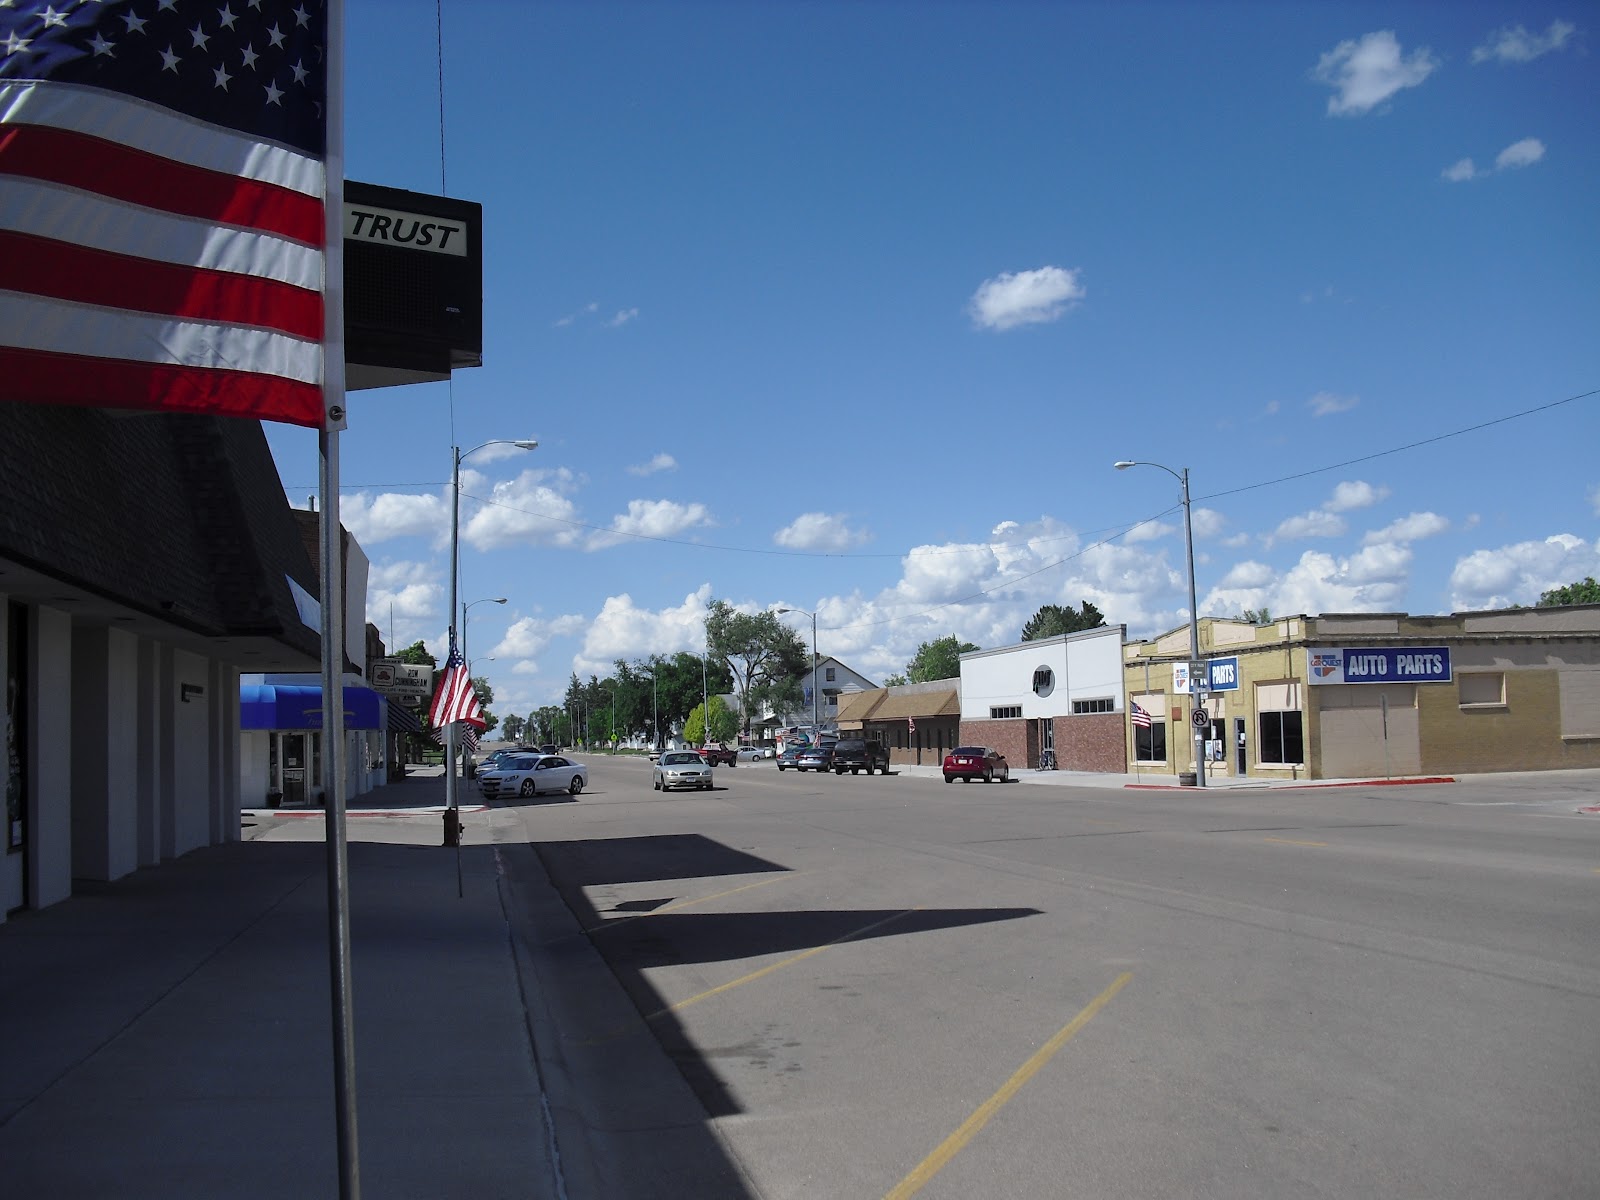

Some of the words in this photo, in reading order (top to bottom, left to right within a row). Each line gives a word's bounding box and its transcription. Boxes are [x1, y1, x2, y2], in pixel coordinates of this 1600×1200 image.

[351, 211, 459, 249] TRUST
[1212, 664, 1235, 684] PARTS
[1348, 655, 1387, 675] AUTO
[1396, 654, 1443, 675] PARTS
